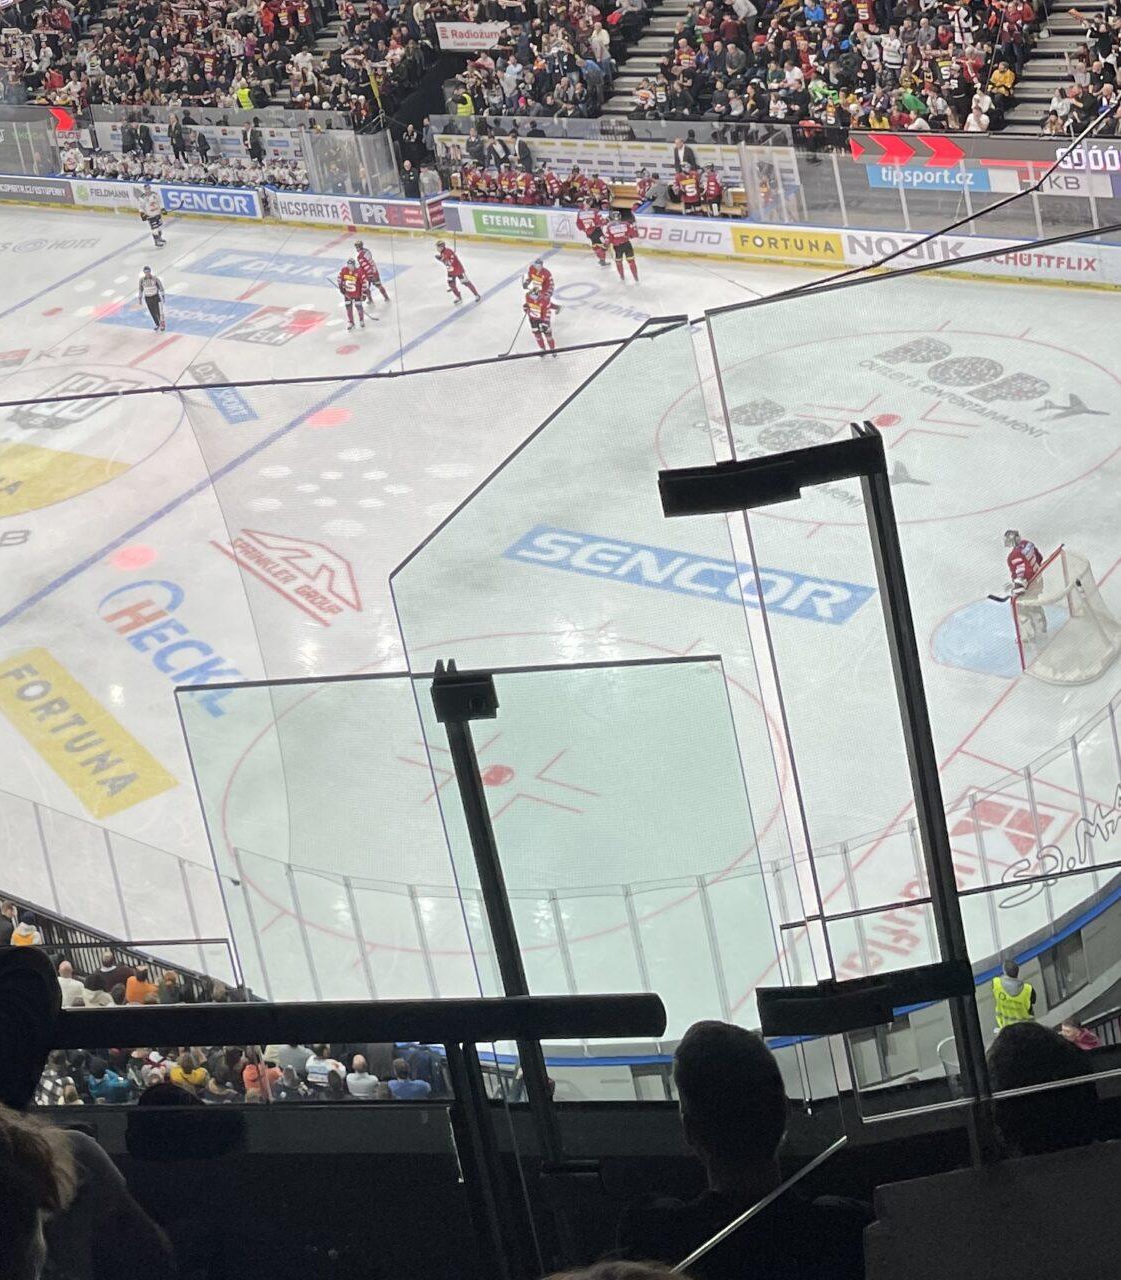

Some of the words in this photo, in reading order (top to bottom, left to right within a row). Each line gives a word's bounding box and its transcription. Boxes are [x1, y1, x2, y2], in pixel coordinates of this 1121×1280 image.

[451, 28, 498, 39] Radiožurn
[1055, 143, 1121, 171] GÓÓÓ
[881, 166, 974, 187] tipsport.cz
[1048, 175, 1080, 190] KB
[89, 187, 129, 201] FIELDMANN
[685, 183, 697, 198] S
[167, 190, 252, 214] SENCOR
[482, 214, 535, 229] ETERNAL
[740, 234, 836, 254] FORTUNA
[345, 280, 357, 292] S
[32, 344, 91, 362] KB
[233, 538, 298, 585] SPRINKLER
[293, 584, 344, 615] GROUP
[518, 530, 856, 623] SENCOR
[0, 662, 142, 799] FORTUNA
